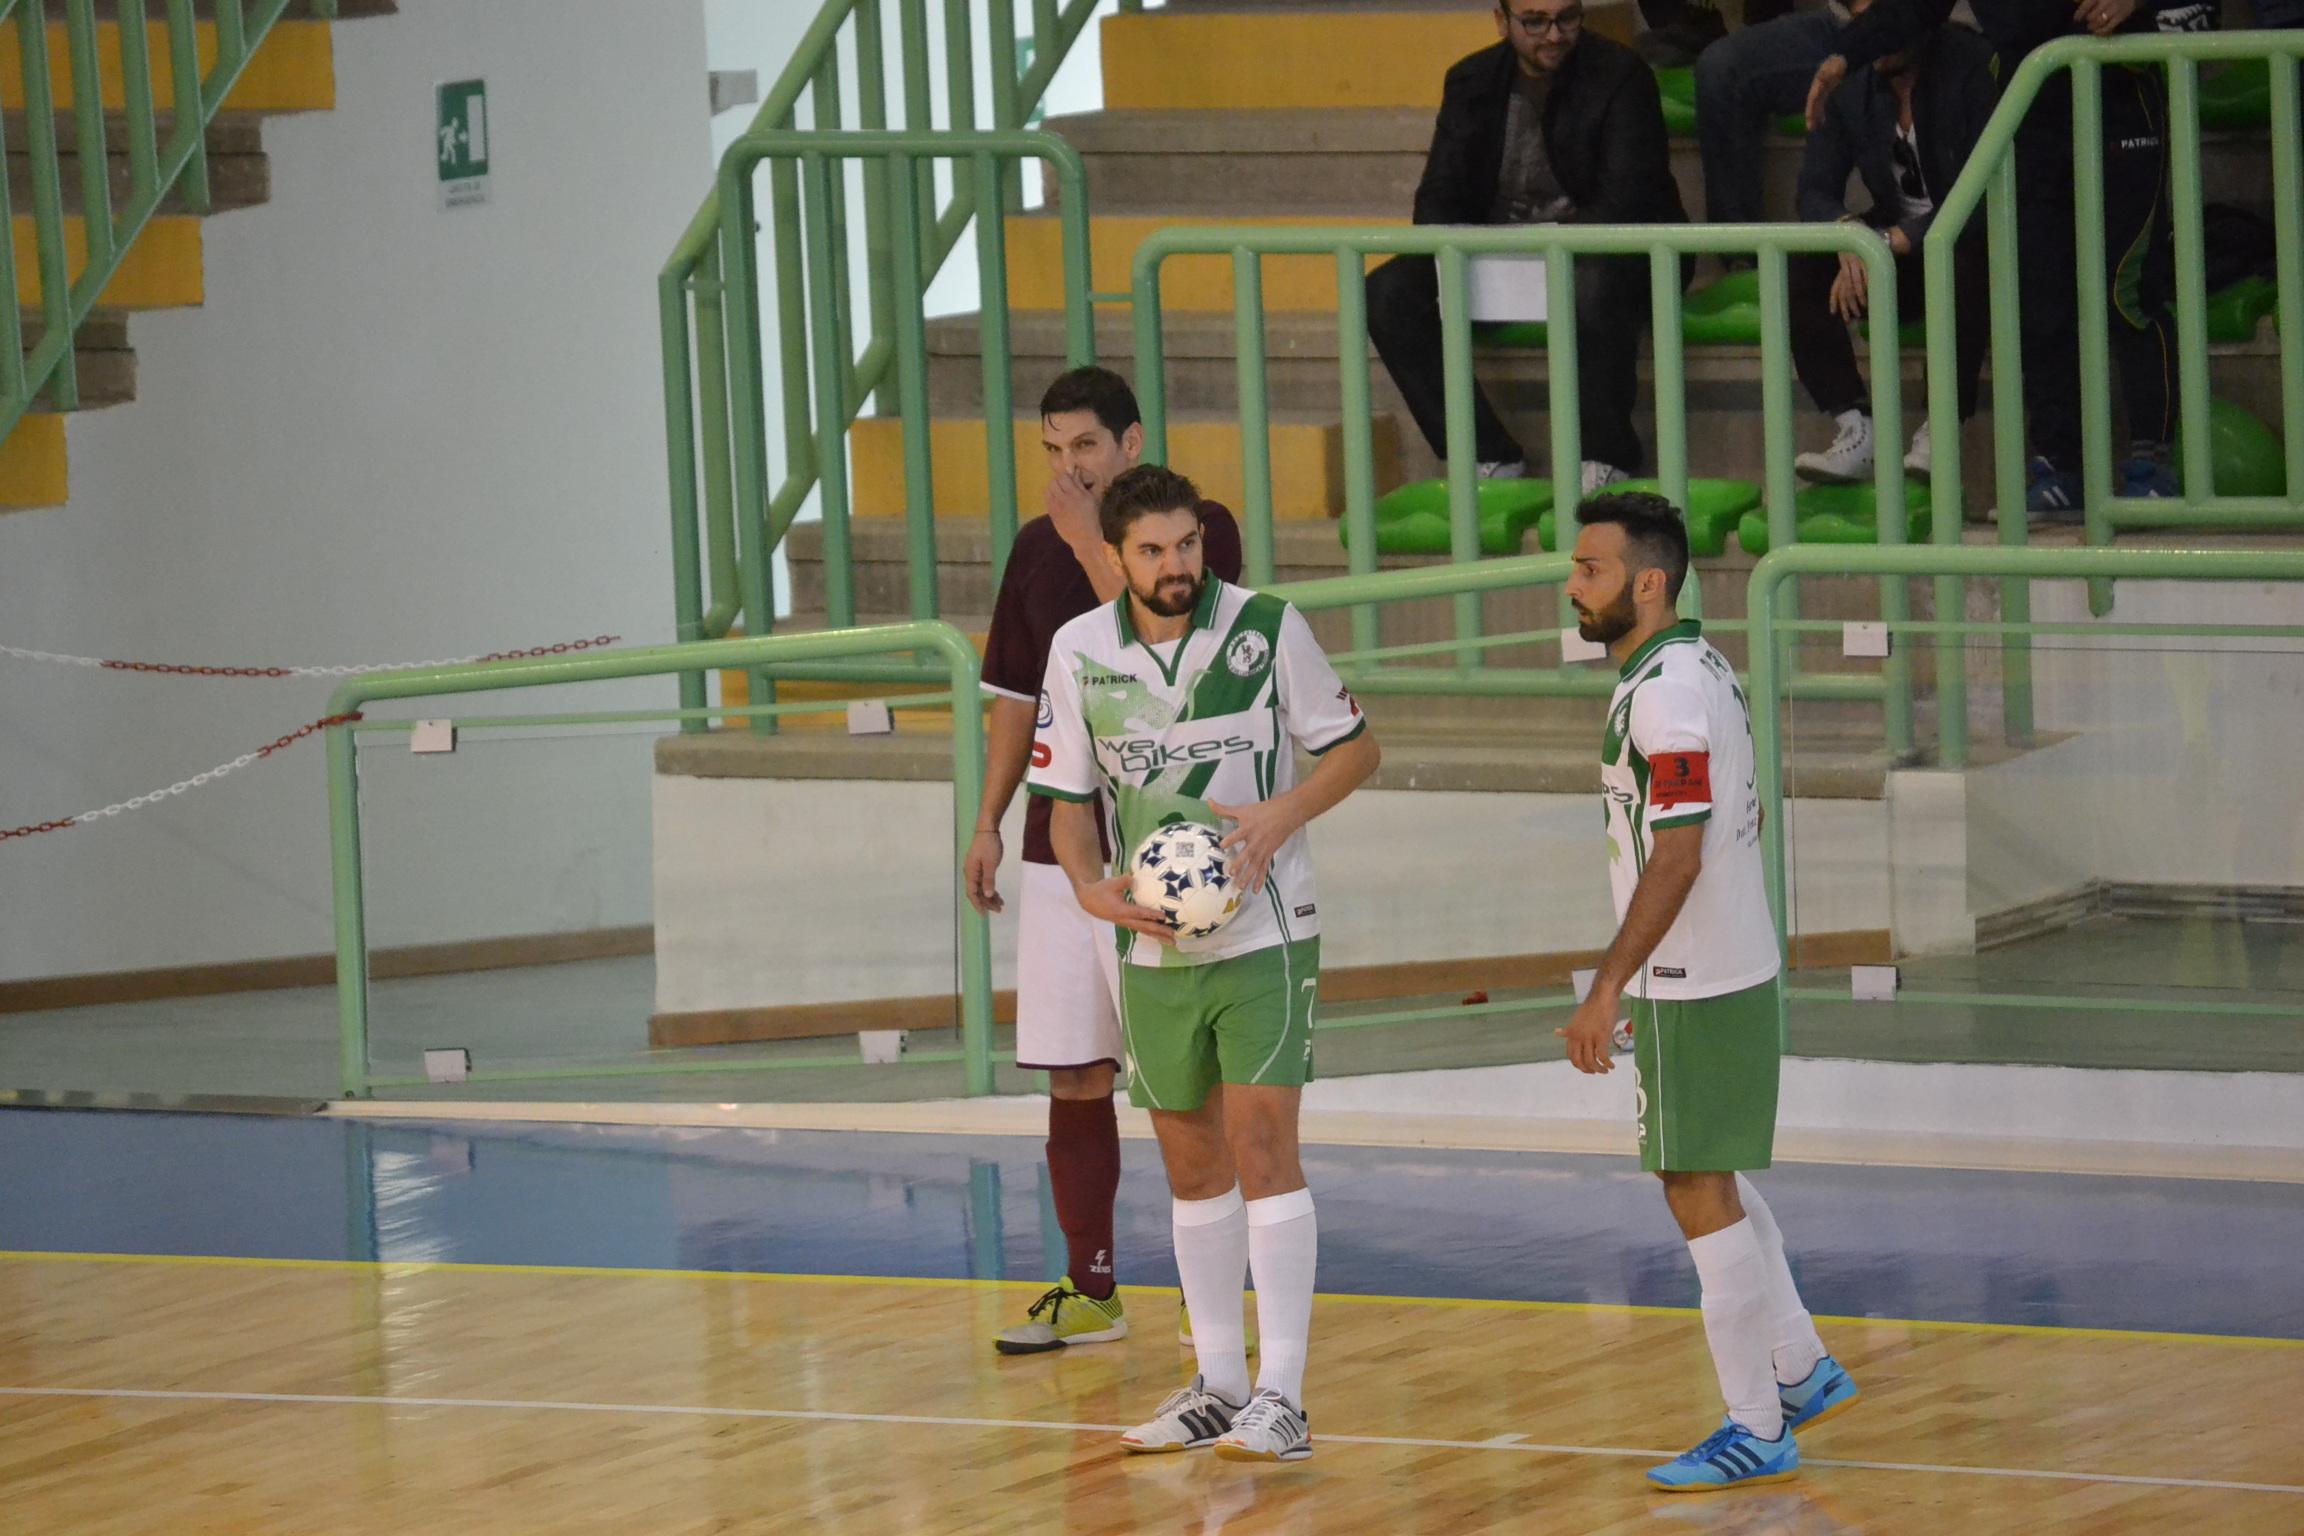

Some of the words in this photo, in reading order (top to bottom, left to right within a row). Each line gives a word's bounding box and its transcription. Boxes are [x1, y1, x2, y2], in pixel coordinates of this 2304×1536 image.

[1092, 673, 1137, 686] PATRICK
[1098, 739, 1156, 753] we
[1120, 736, 1254, 772] bikes
